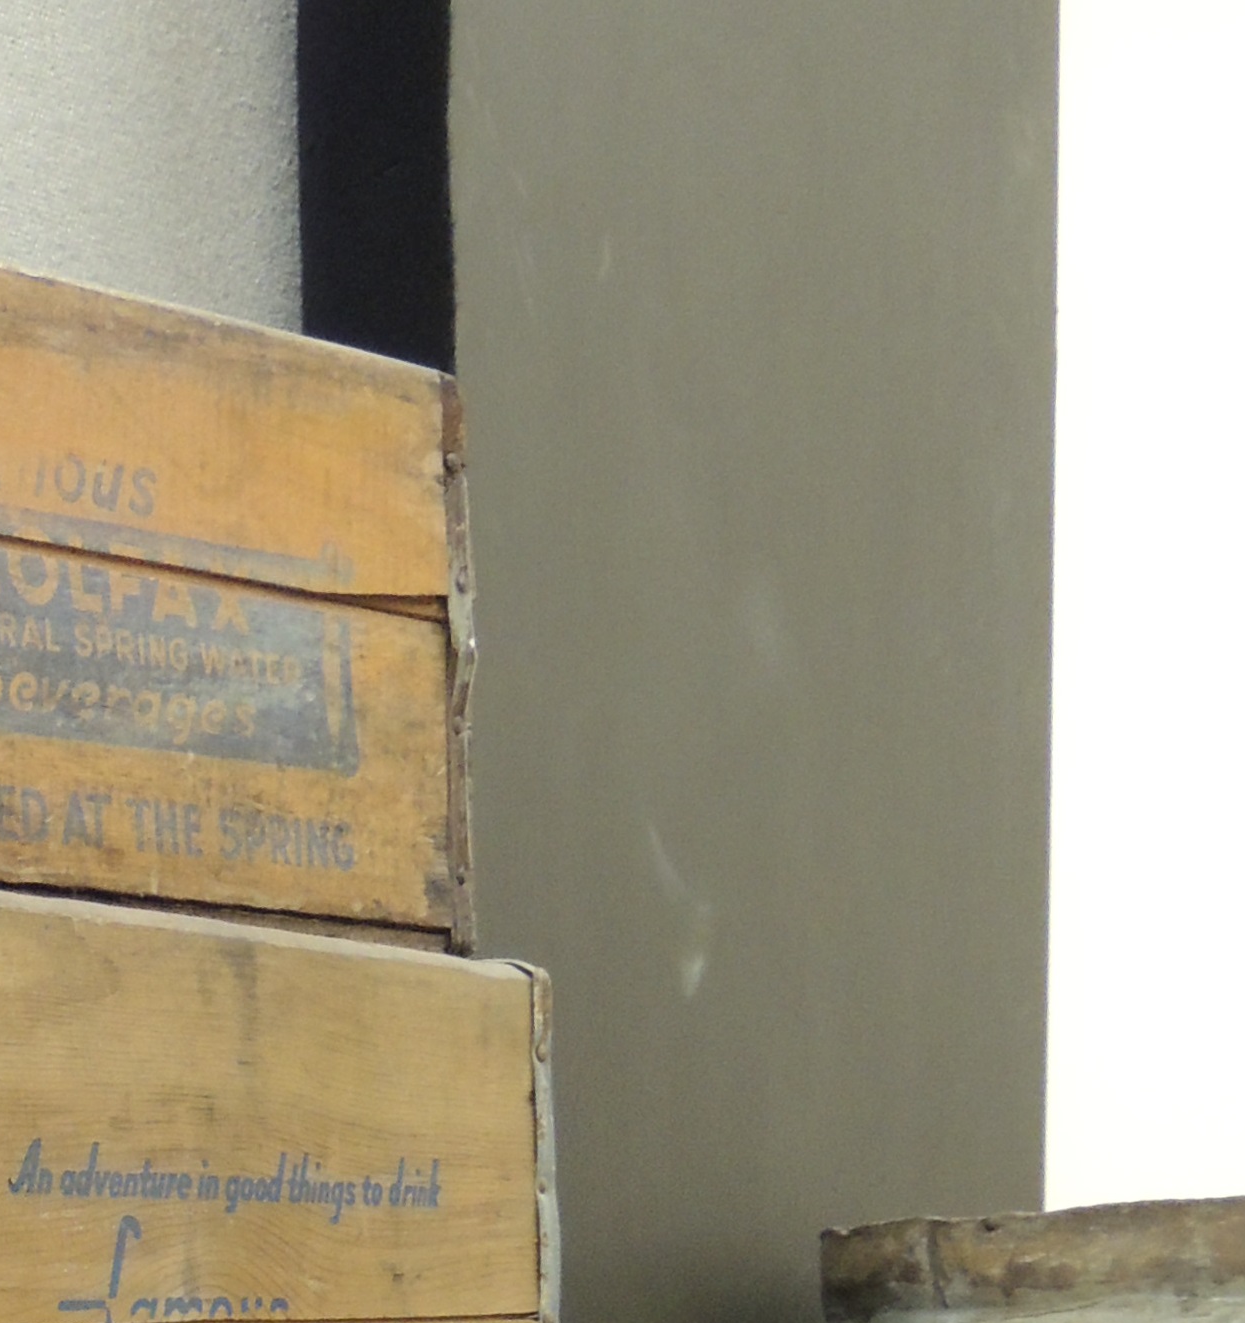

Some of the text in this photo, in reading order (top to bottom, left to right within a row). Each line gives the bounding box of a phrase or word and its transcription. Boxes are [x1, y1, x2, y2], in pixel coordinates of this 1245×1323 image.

[75, 620, 190, 674] SPRING
[62, 793, 113, 849] AT
[127, 799, 205, 857] THE
[218, 815, 356, 873] SPRING
[8, 1137, 442, 1225] An adventure in good things to drink
